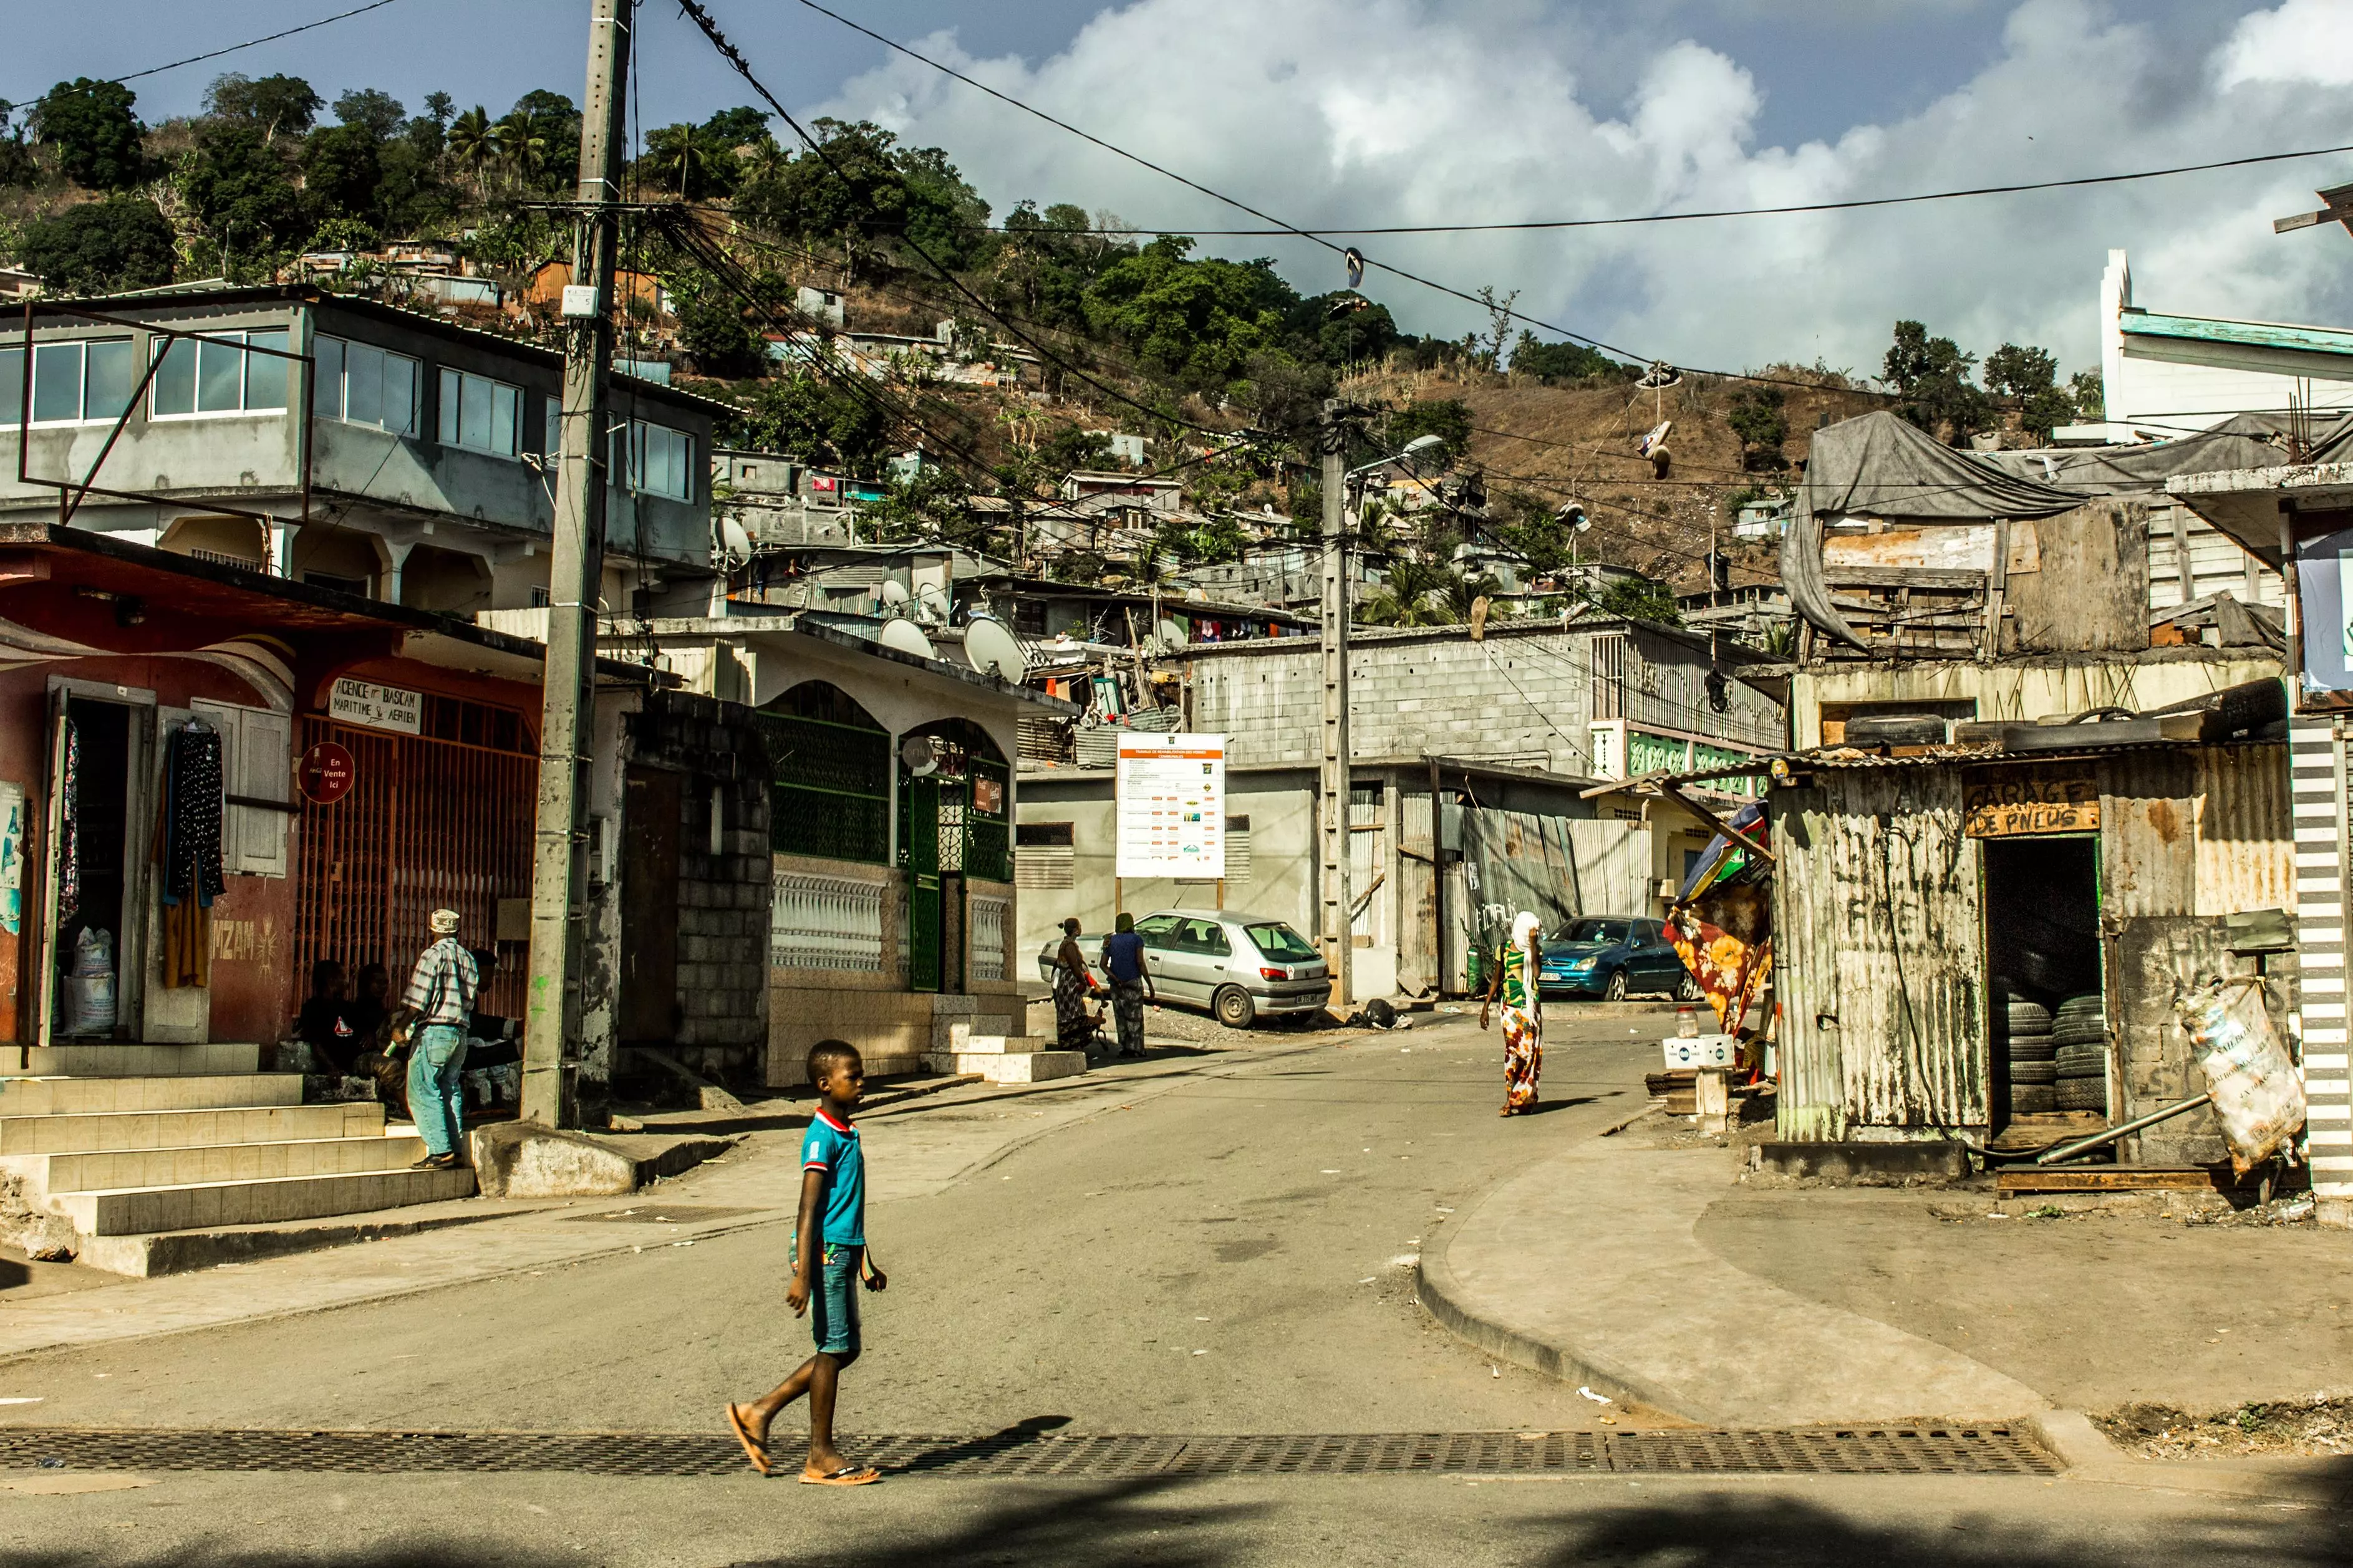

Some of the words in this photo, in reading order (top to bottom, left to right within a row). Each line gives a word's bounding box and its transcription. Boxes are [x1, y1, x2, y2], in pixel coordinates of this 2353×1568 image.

[331, 758, 341, 767] En
[324, 769, 346, 777] Vente
[329, 781, 339, 789] Ici
[2006, 809, 2078, 832] PNEUS
